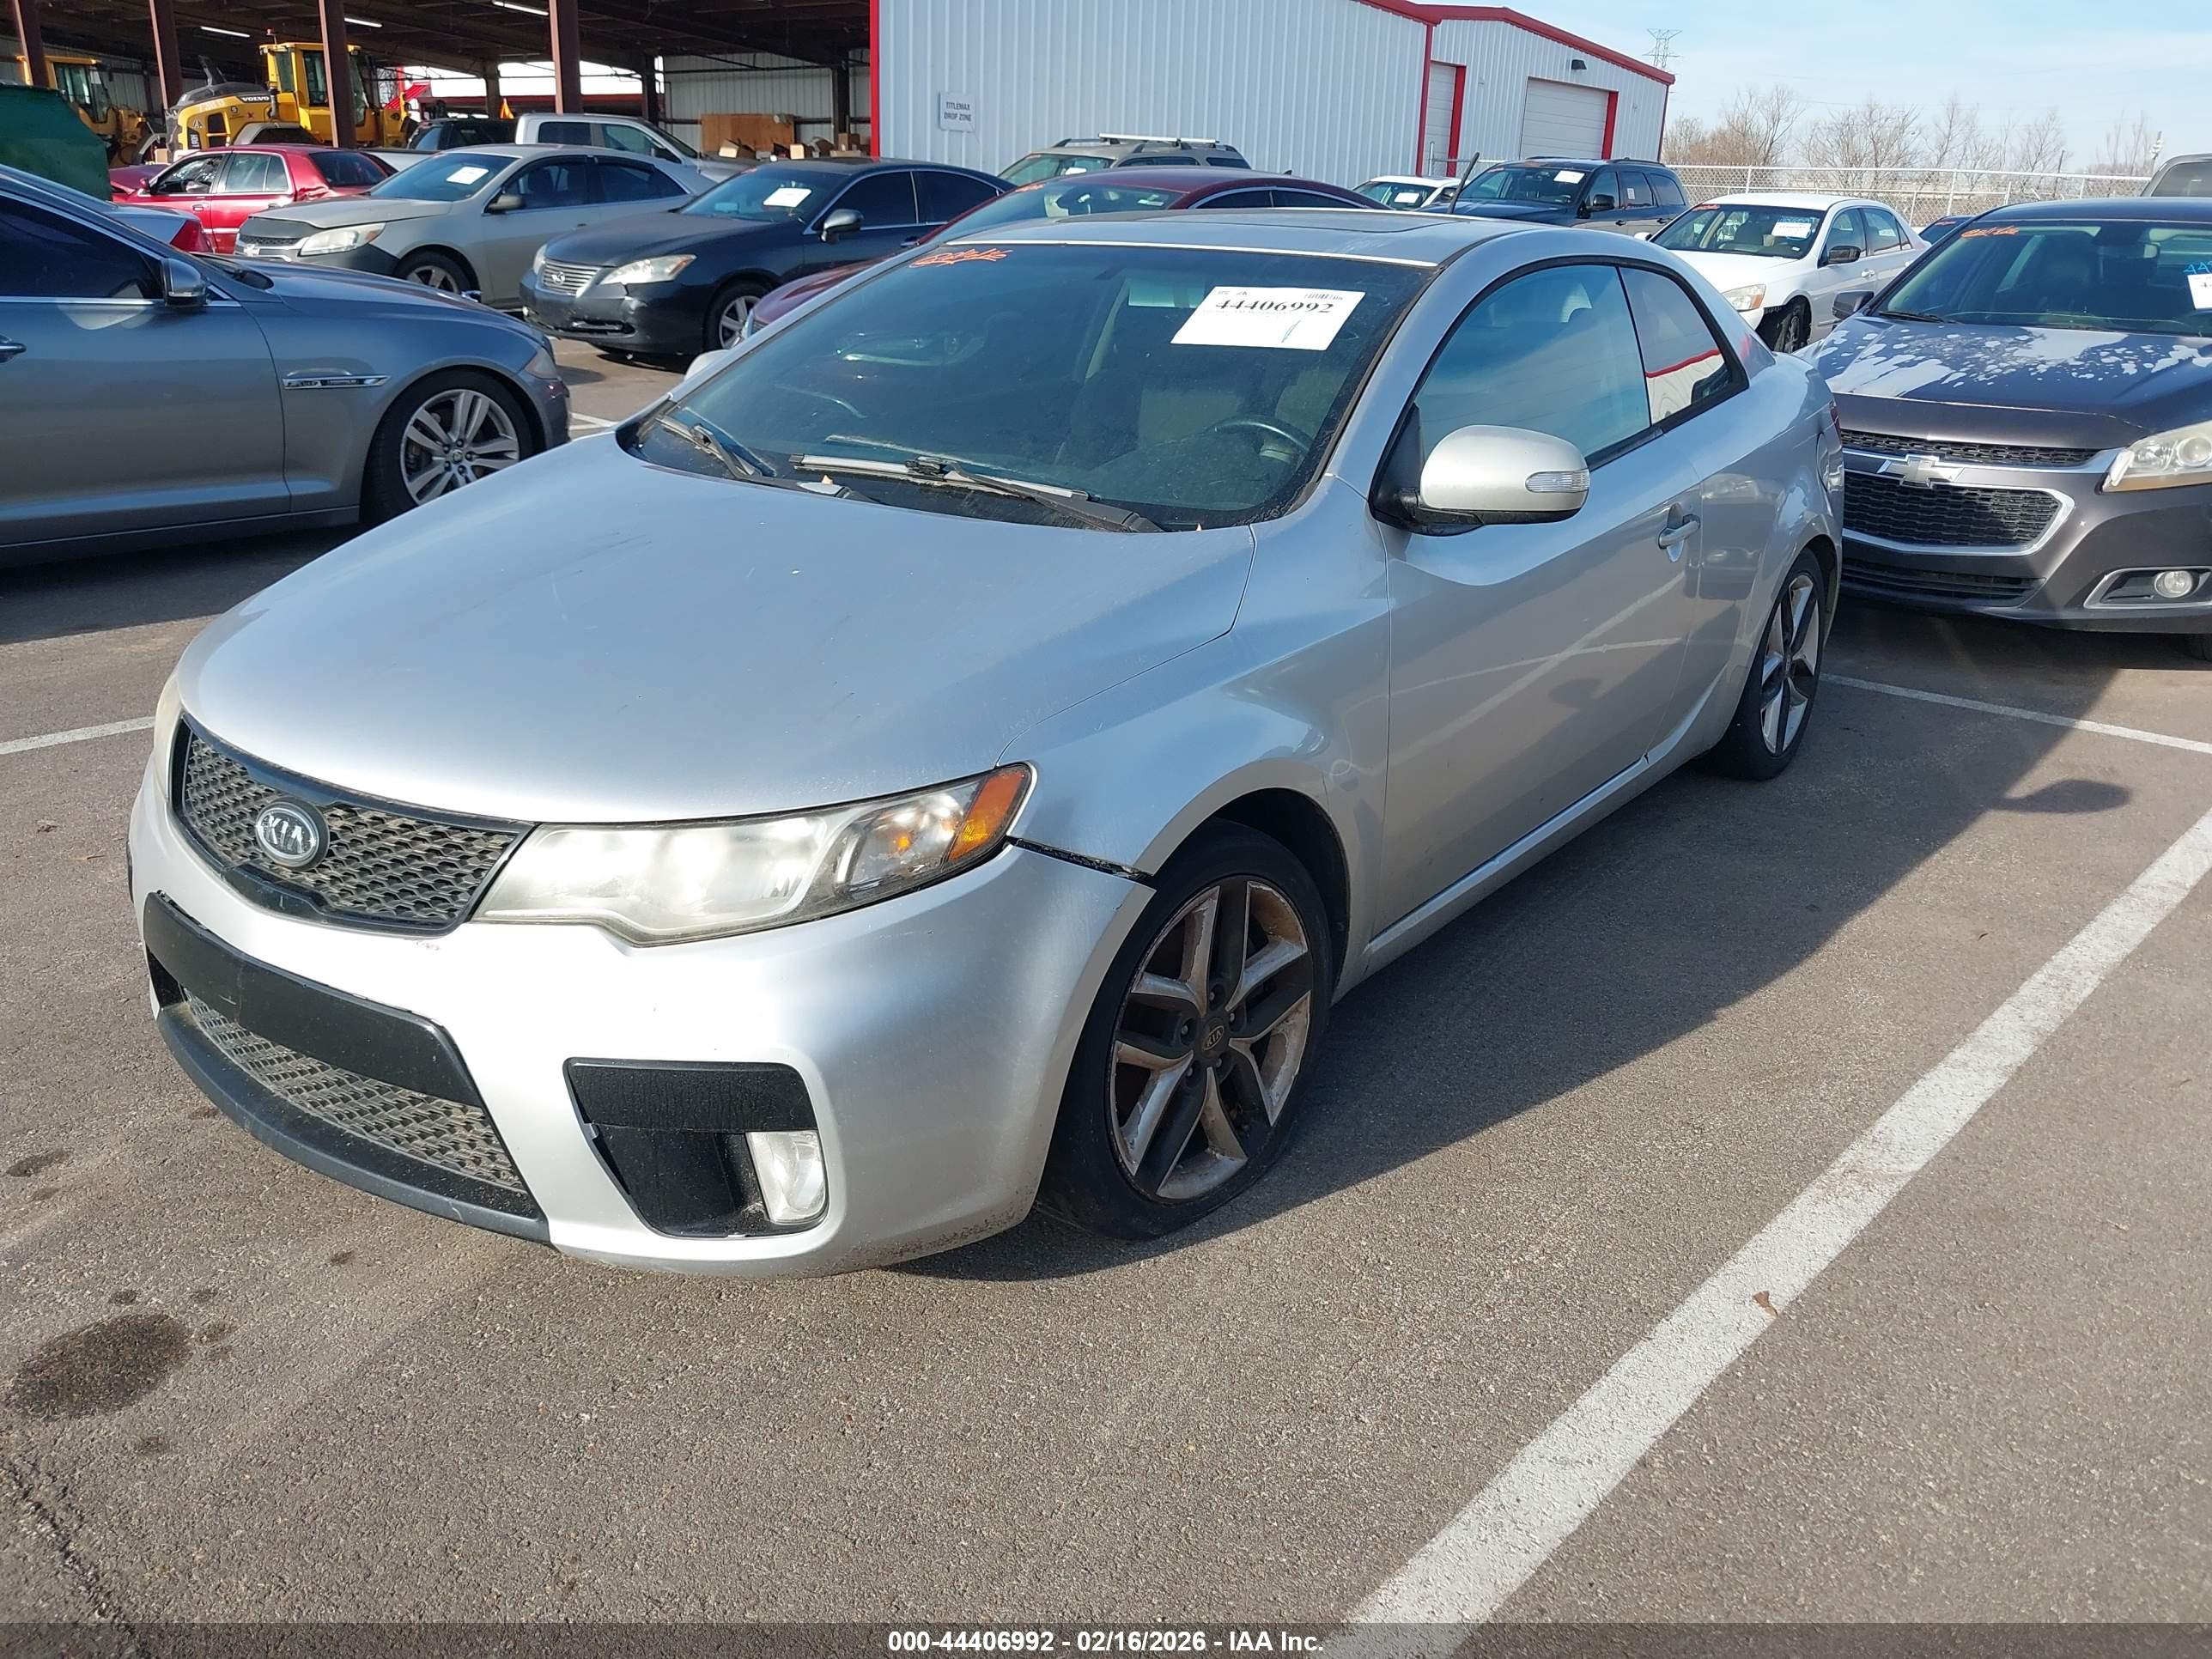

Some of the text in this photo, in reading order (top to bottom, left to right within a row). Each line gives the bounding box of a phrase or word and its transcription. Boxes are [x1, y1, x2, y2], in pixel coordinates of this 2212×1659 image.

[944, 112, 971, 122] DROP ZONE
[1215, 299, 1334, 313] 44406992
[264, 812, 303, 854] KIA
[1206, 1029, 1222, 1047] KIA
